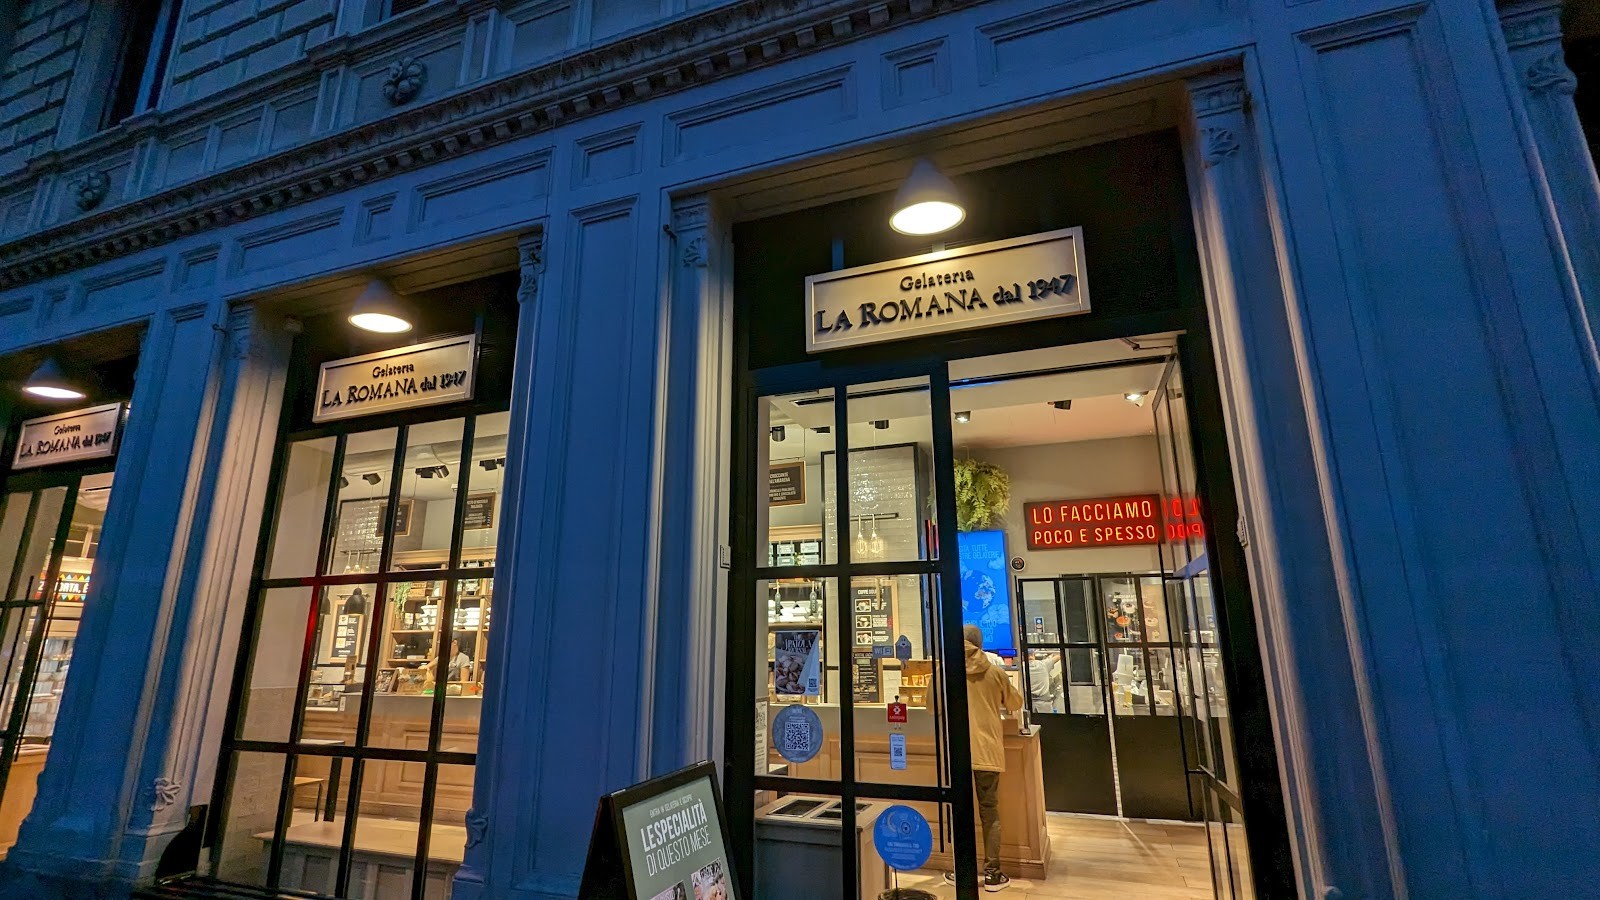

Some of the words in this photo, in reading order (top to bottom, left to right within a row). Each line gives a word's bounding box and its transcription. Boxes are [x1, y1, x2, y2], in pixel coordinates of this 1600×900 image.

[900, 268, 975, 291] Gelateria
[814, 309, 853, 333] LA
[858, 288, 987, 327] ROMANA
[992, 282, 1022, 304] dal
[1027, 274, 1077, 299] 1947
[372, 363, 415, 378] Gelateria
[322, 389, 342, 407] LA
[345, 377, 418, 404] ROMANA
[420, 375, 436, 392] dal
[439, 370, 467, 389] 1947
[20, 442, 33, 457] LA
[36, 435, 81, 455] ROMANA
[1033, 507, 1053, 525] LO
[1060, 500, 1152, 522] FACCIAMO
[1034, 529, 1073, 545] POCO
[1079, 528, 1088, 543] E
[1094, 524, 1156, 542] SPESSO
[640, 824, 657, 853] LE
[654, 799, 708, 846] SPECIALITÀ
[646, 853, 658, 877] DI
[658, 836, 691, 871] QUESTO
[689, 825, 712, 853] MESE
